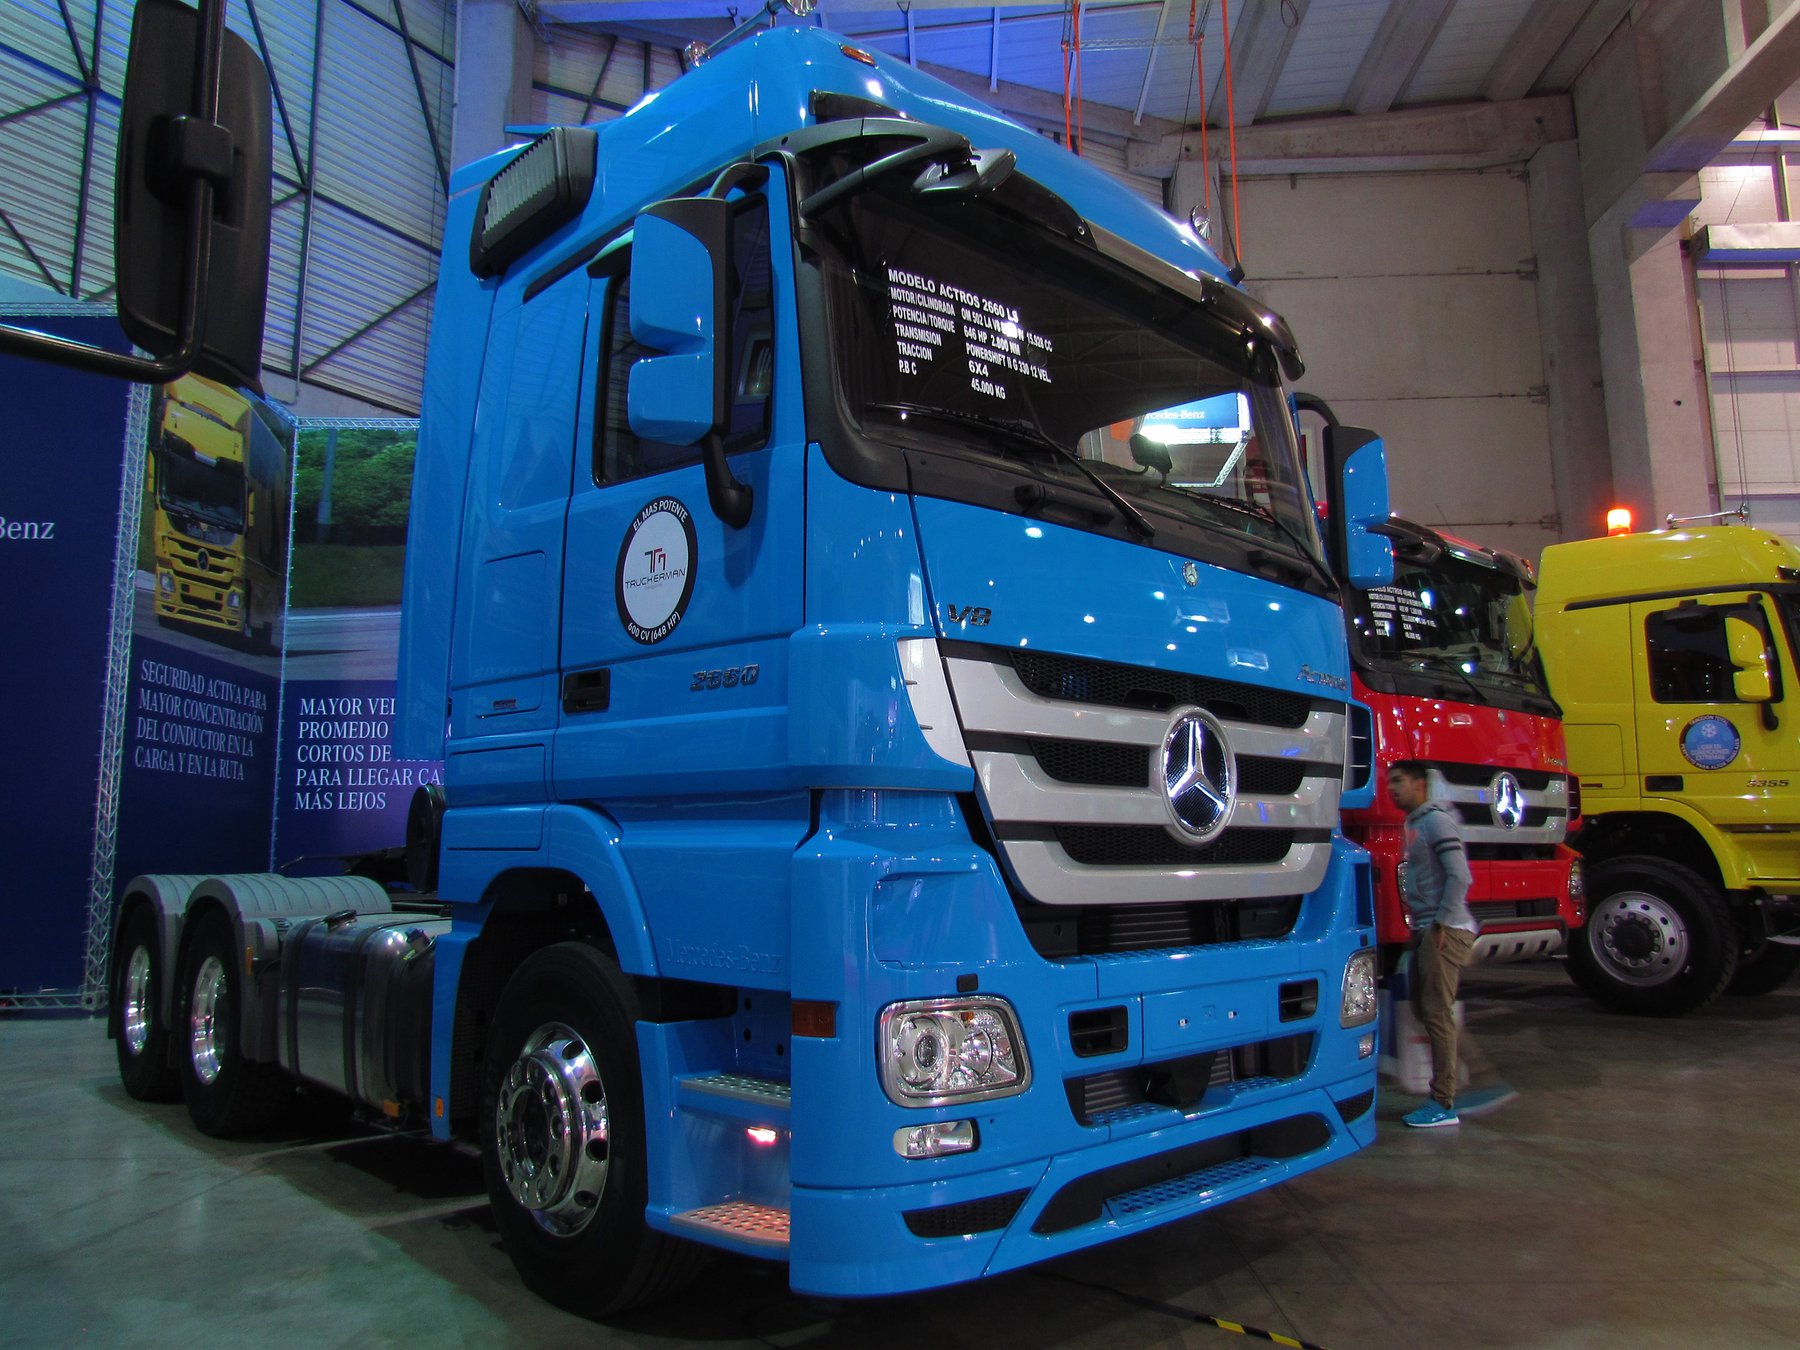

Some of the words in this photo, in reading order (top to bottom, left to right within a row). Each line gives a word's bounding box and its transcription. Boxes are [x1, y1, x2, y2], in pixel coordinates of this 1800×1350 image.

[888, 268, 936, 293] MODELO
[939, 283, 980, 309] ACTROS
[982, 298, 1005, 318] 2660
[1006, 307, 1019, 323] LS
[890, 286, 956, 317] MOTOR/CILINDRADA
[961, 307, 972, 321] OM
[983, 315, 993, 330] LA
[892, 304, 956, 334] POTENCIA/TORQUE
[963, 325, 977, 340] 646
[977, 329, 988, 344] HP
[894, 322, 942, 347] TRANSMISION
[965, 342, 1006, 367] POWERSHIFT
[1012, 359, 1018, 371] G
[1030, 364, 1038, 379] 12
[896, 340, 933, 361] TRACCION
[968, 359, 989, 378] 6X4
[971, 377, 995, 397] 45.000
[994, 385, 1006, 400] KG
[633, 518, 643, 531] EL
[642, 502, 658, 519] MAS
[659, 500, 688, 523] POTENTE
[628, 622, 640, 638] 600
[640, 630, 650, 641] CV
[650, 625, 667, 643] (648
[667, 610, 681, 631] HP)
[947, 603, 993, 627] V8
[141, 659, 205, 695] SEGURIDAD
[206, 679, 241, 704] ACTIVA
[244, 687, 267, 711] PARA
[690, 664, 759, 691] 2660
[139, 687, 181, 717] MAYOR
[183, 698, 264, 734] CONCENTRACIÓN
[300, 698, 362, 716] MAYOR
[137, 716, 159, 741] DEL
[162, 721, 225, 752] CONDUCTOR
[227, 734, 240, 754] EN
[242, 736, 254, 757] LA
[298, 721, 389, 739] PROMEDIO
[135, 745, 175, 772] CARGA
[178, 752, 186, 773] Y
[187, 753, 202, 775] EN
[204, 755, 217, 777] LA
[219, 758, 244, 781] RUTA
[297, 744, 365, 763] CORTOS
[369, 744, 392, 763] DE
[296, 768, 342, 786] PARA
[347, 768, 413, 786] LLEGAR
[418, 767, 445, 787] CA
[295, 787, 333, 810] MÁS
[337, 791, 386, 811] LEJOS
[665, 937, 781, 975] Mercedes-Benz
